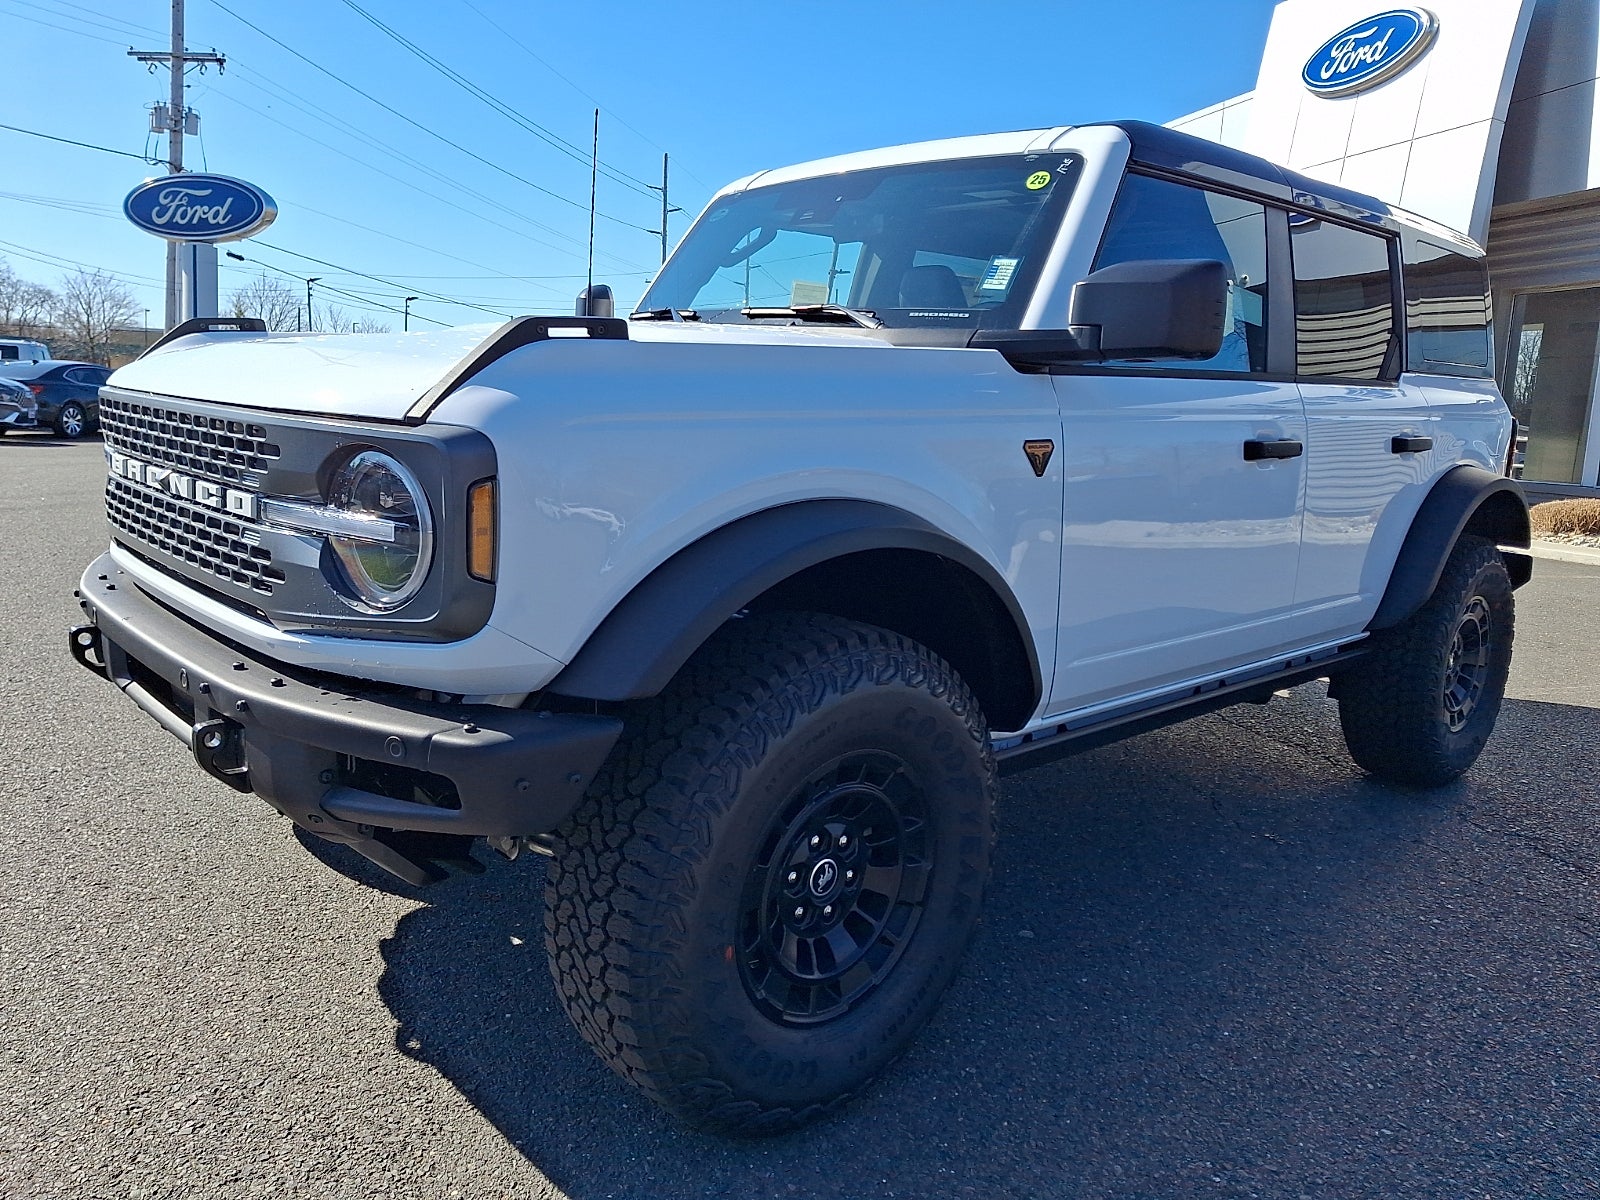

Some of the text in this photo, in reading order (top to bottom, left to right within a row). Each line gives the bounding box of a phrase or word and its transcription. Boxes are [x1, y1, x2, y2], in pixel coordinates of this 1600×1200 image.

[1320, 26, 1396, 80] Ford
[1029, 174, 1049, 185] 25
[151, 187, 234, 225] Ford
[110, 451, 257, 519] BRONCO
